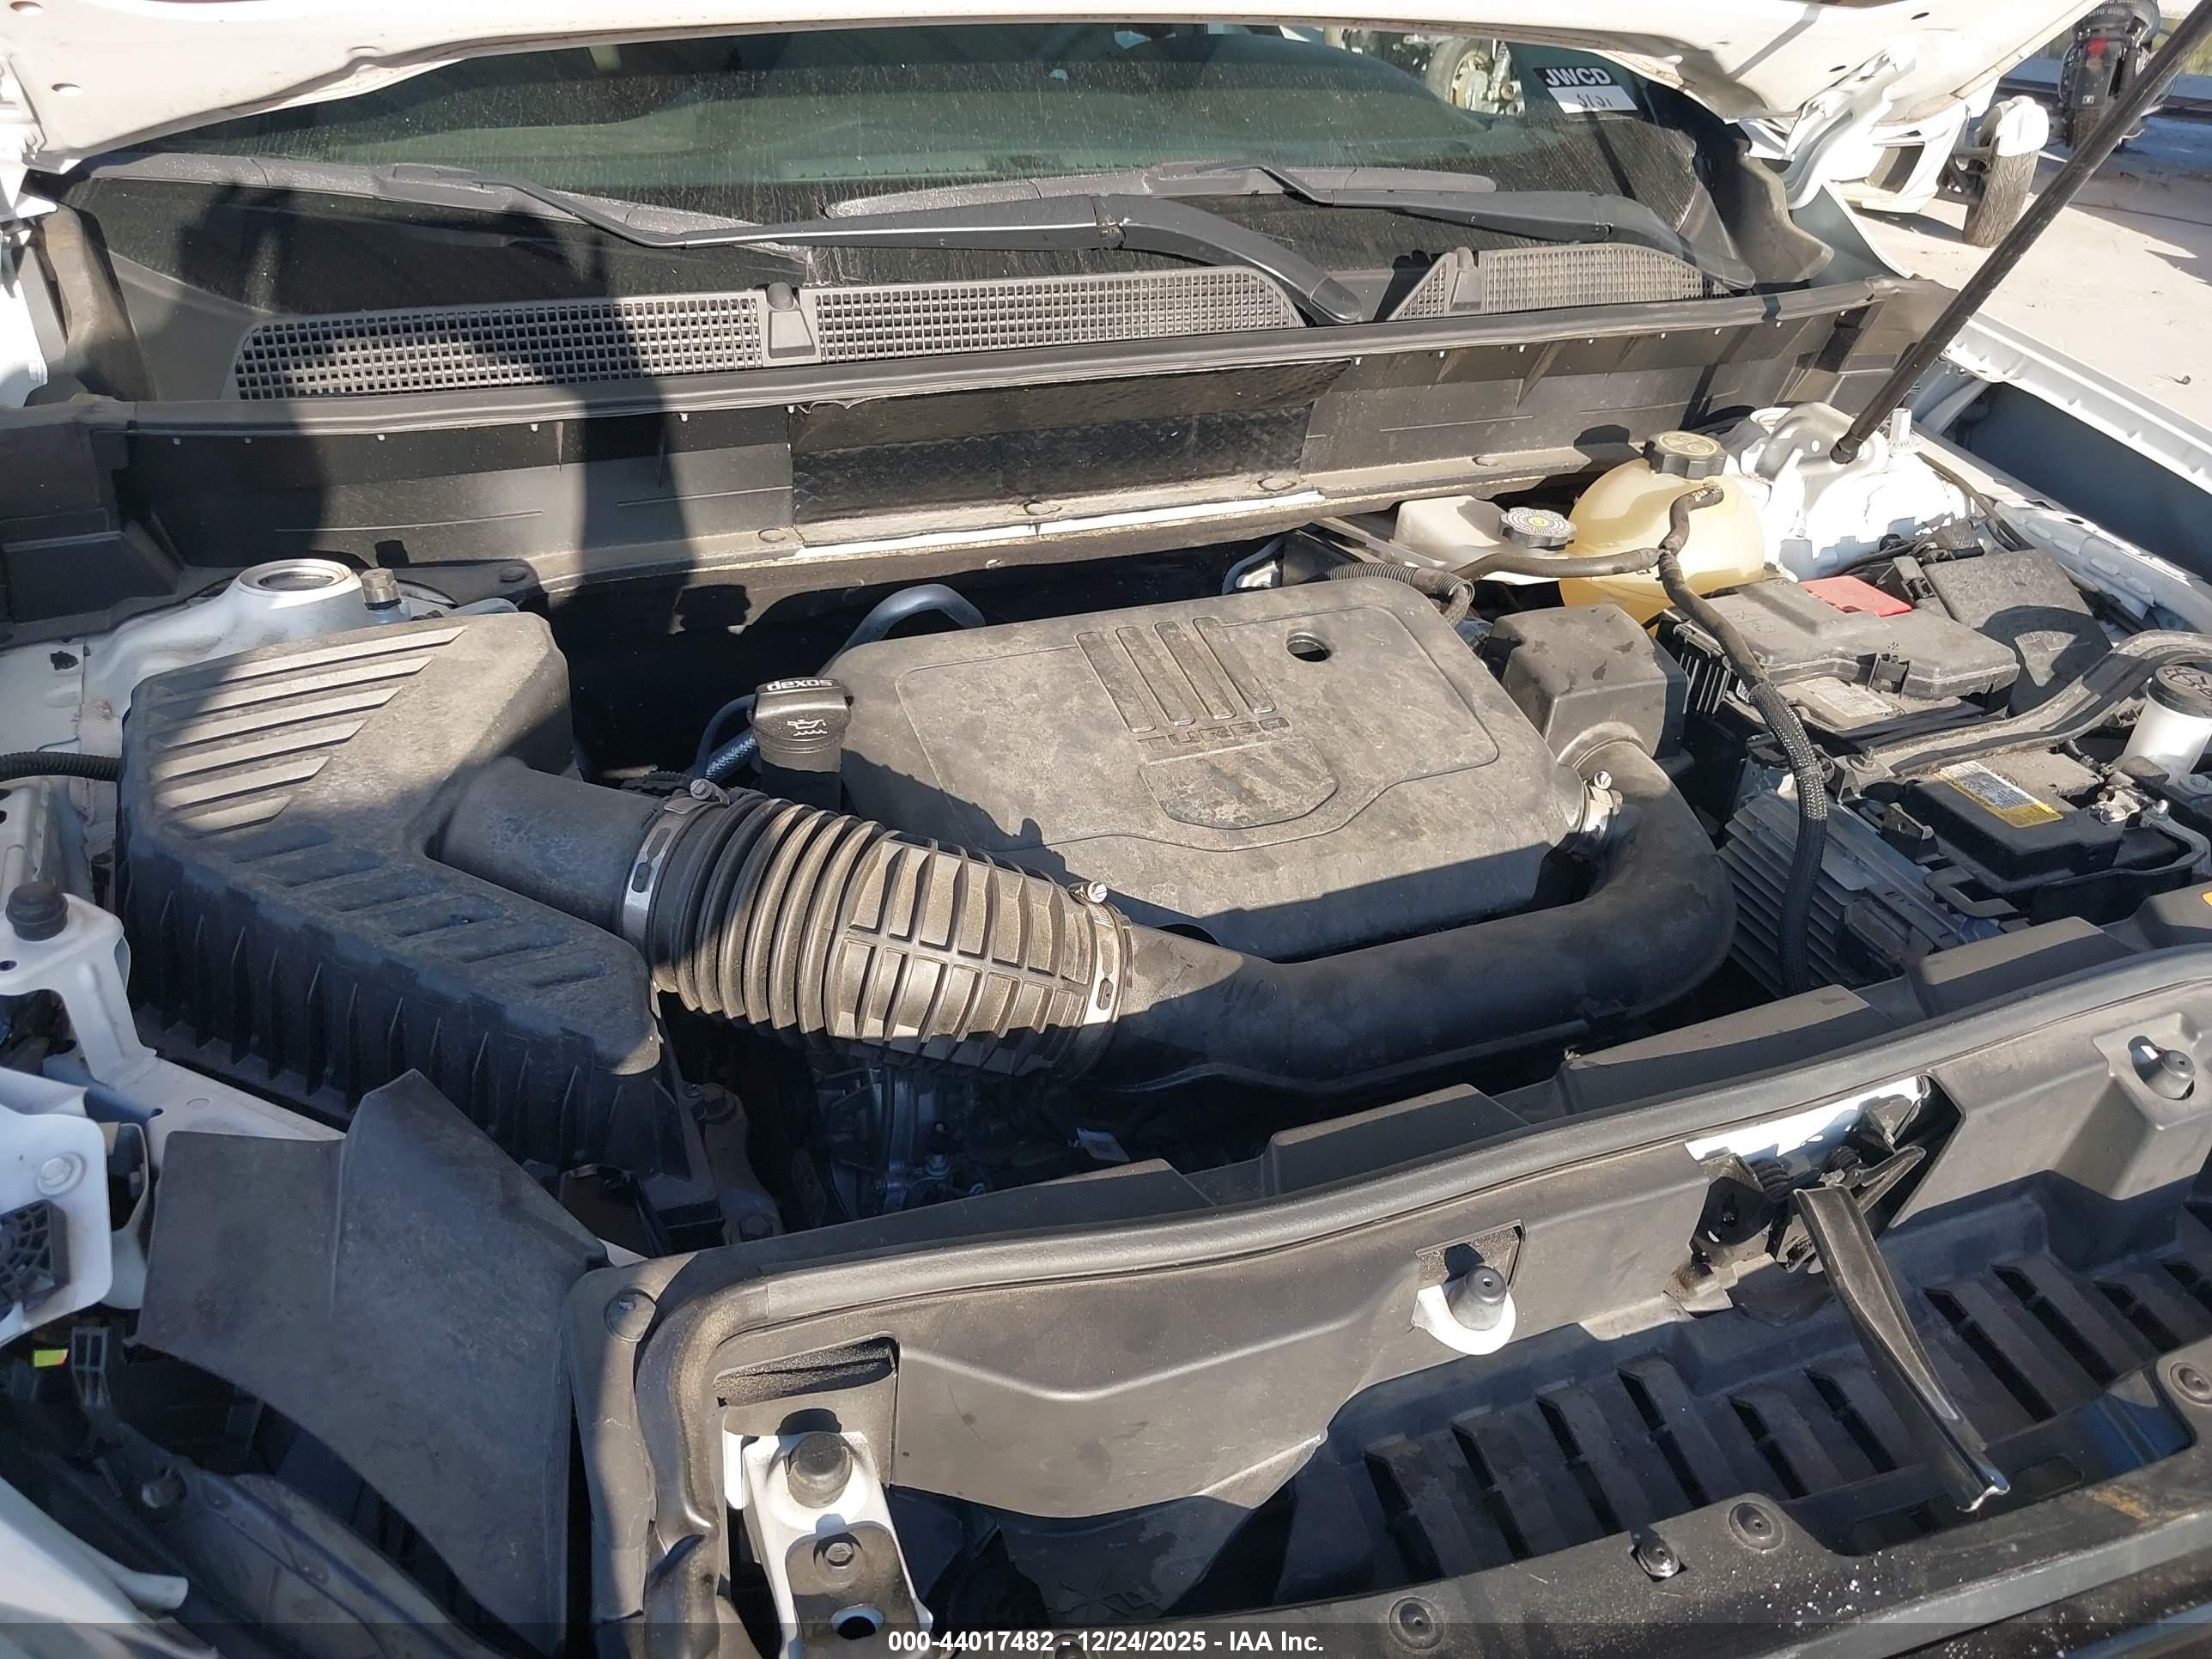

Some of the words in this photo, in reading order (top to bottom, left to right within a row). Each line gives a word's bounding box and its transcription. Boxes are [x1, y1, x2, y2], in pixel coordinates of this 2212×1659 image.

[1545, 67, 1612, 86] JWCD
[767, 679, 834, 692] dexos
[1136, 716, 1291, 750] TURBO
